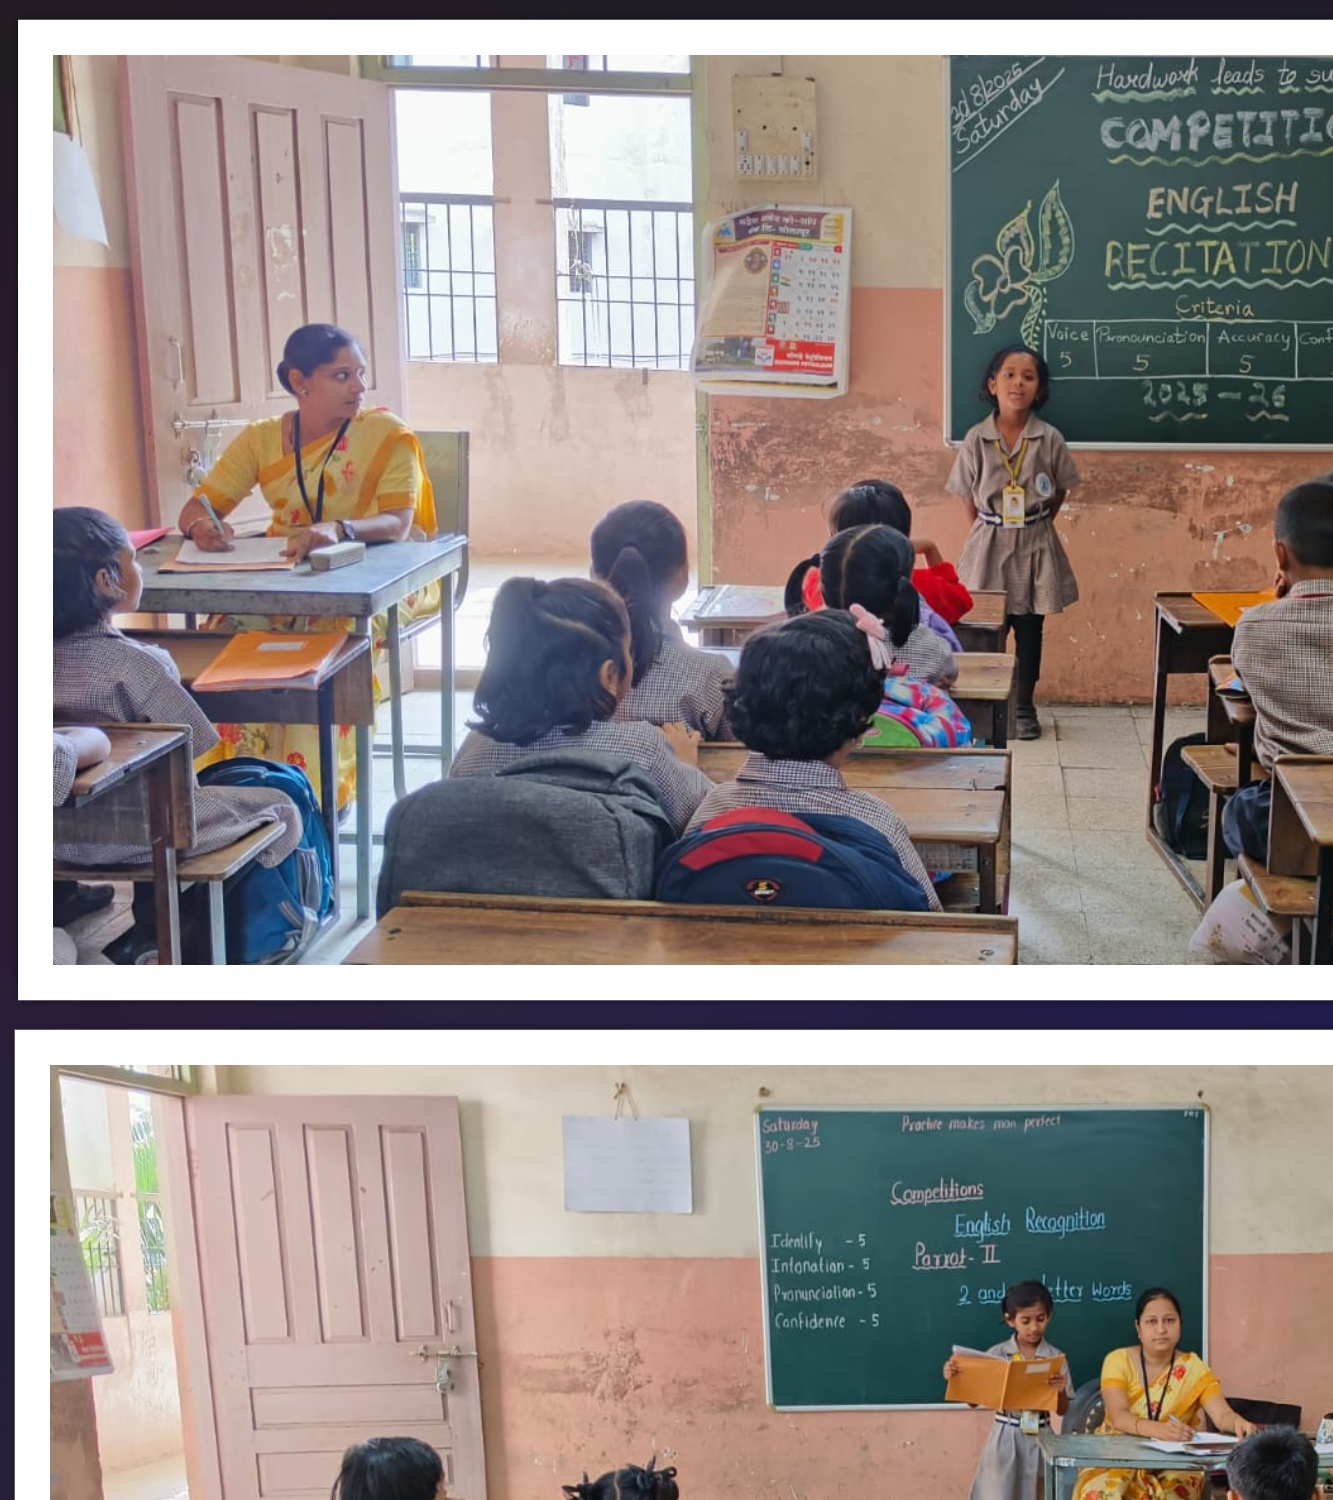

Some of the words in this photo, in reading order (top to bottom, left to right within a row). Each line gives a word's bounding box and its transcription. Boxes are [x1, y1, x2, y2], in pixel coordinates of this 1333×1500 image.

[1097, 57, 1199, 89] Hardwork
[1211, 57, 1265, 86] leads
[1278, 57, 1297, 85] to
[956, 78, 1043, 153] Saturday
[1147, 181, 1298, 219] ENGLISH
[1105, 236, 1332, 278] RECITATION
[1175, 295, 1255, 317] Criteria
[1048, 323, 1090, 342] Voice
[1218, 329, 1291, 351] Accuracy
[1060, 352, 1072, 367] 5
[1132, 354, 1150, 371] 5
[1238, 355, 1255, 373] 5
[762, 1116, 819, 1135] Saturday
[949, 1117, 985, 1130] makes
[1024, 1114, 1061, 1135] perfect
[891, 1177, 984, 1205] Competitions
[954, 1211, 1011, 1243] English
[1025, 1206, 1106, 1239] Recognition
[769, 1231, 822, 1255] Identify
[858, 1233, 866, 1247] 5
[981, 1244, 1001, 1264] II
[771, 1256, 844, 1274] Intonation
[862, 1257, 870, 1270] 5
[774, 1284, 855, 1303] Pronunciation
[867, 1283, 877, 1298] 5
[959, 1284, 971, 1300] 2
[978, 1281, 1006, 1300] and
[775, 1312, 846, 1329] Confidence
[871, 1313, 880, 1327] 5
